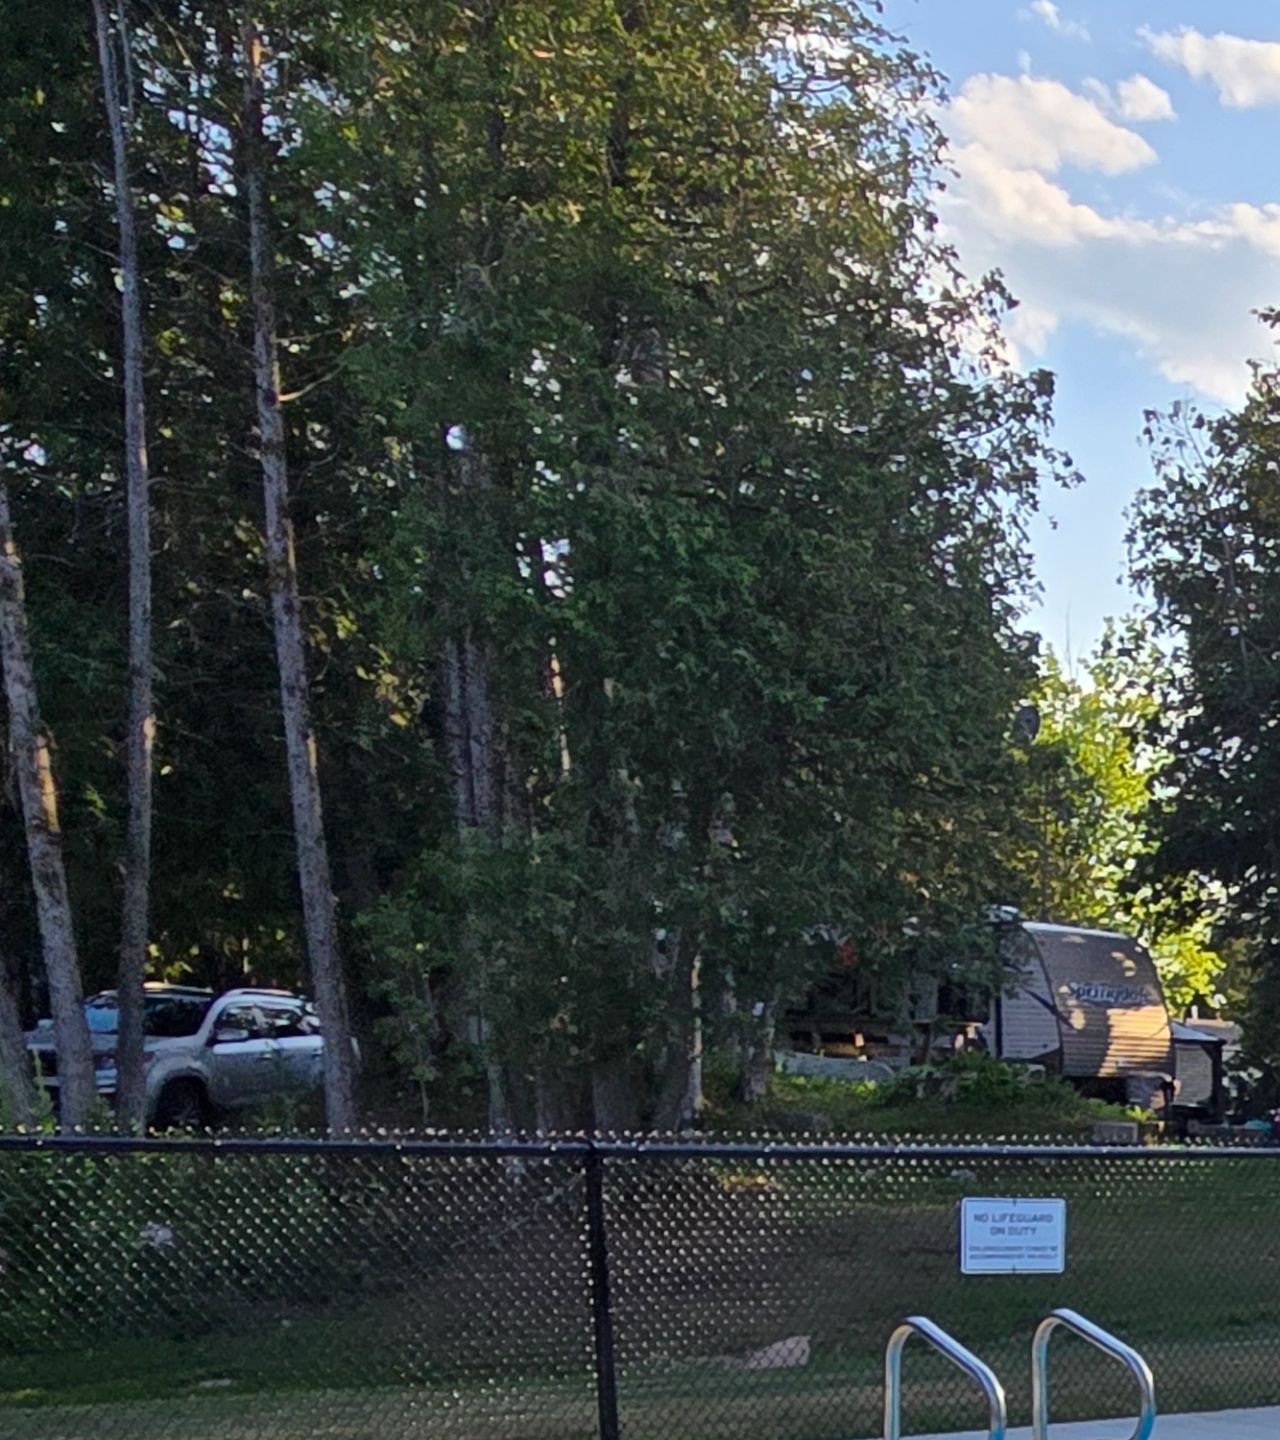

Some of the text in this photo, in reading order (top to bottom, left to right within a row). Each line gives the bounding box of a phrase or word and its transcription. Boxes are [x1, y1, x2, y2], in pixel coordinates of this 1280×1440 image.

[973, 1213, 1053, 1223] NO LIFEGUARD
[990, 1226, 1036, 1236] ON DUTY
